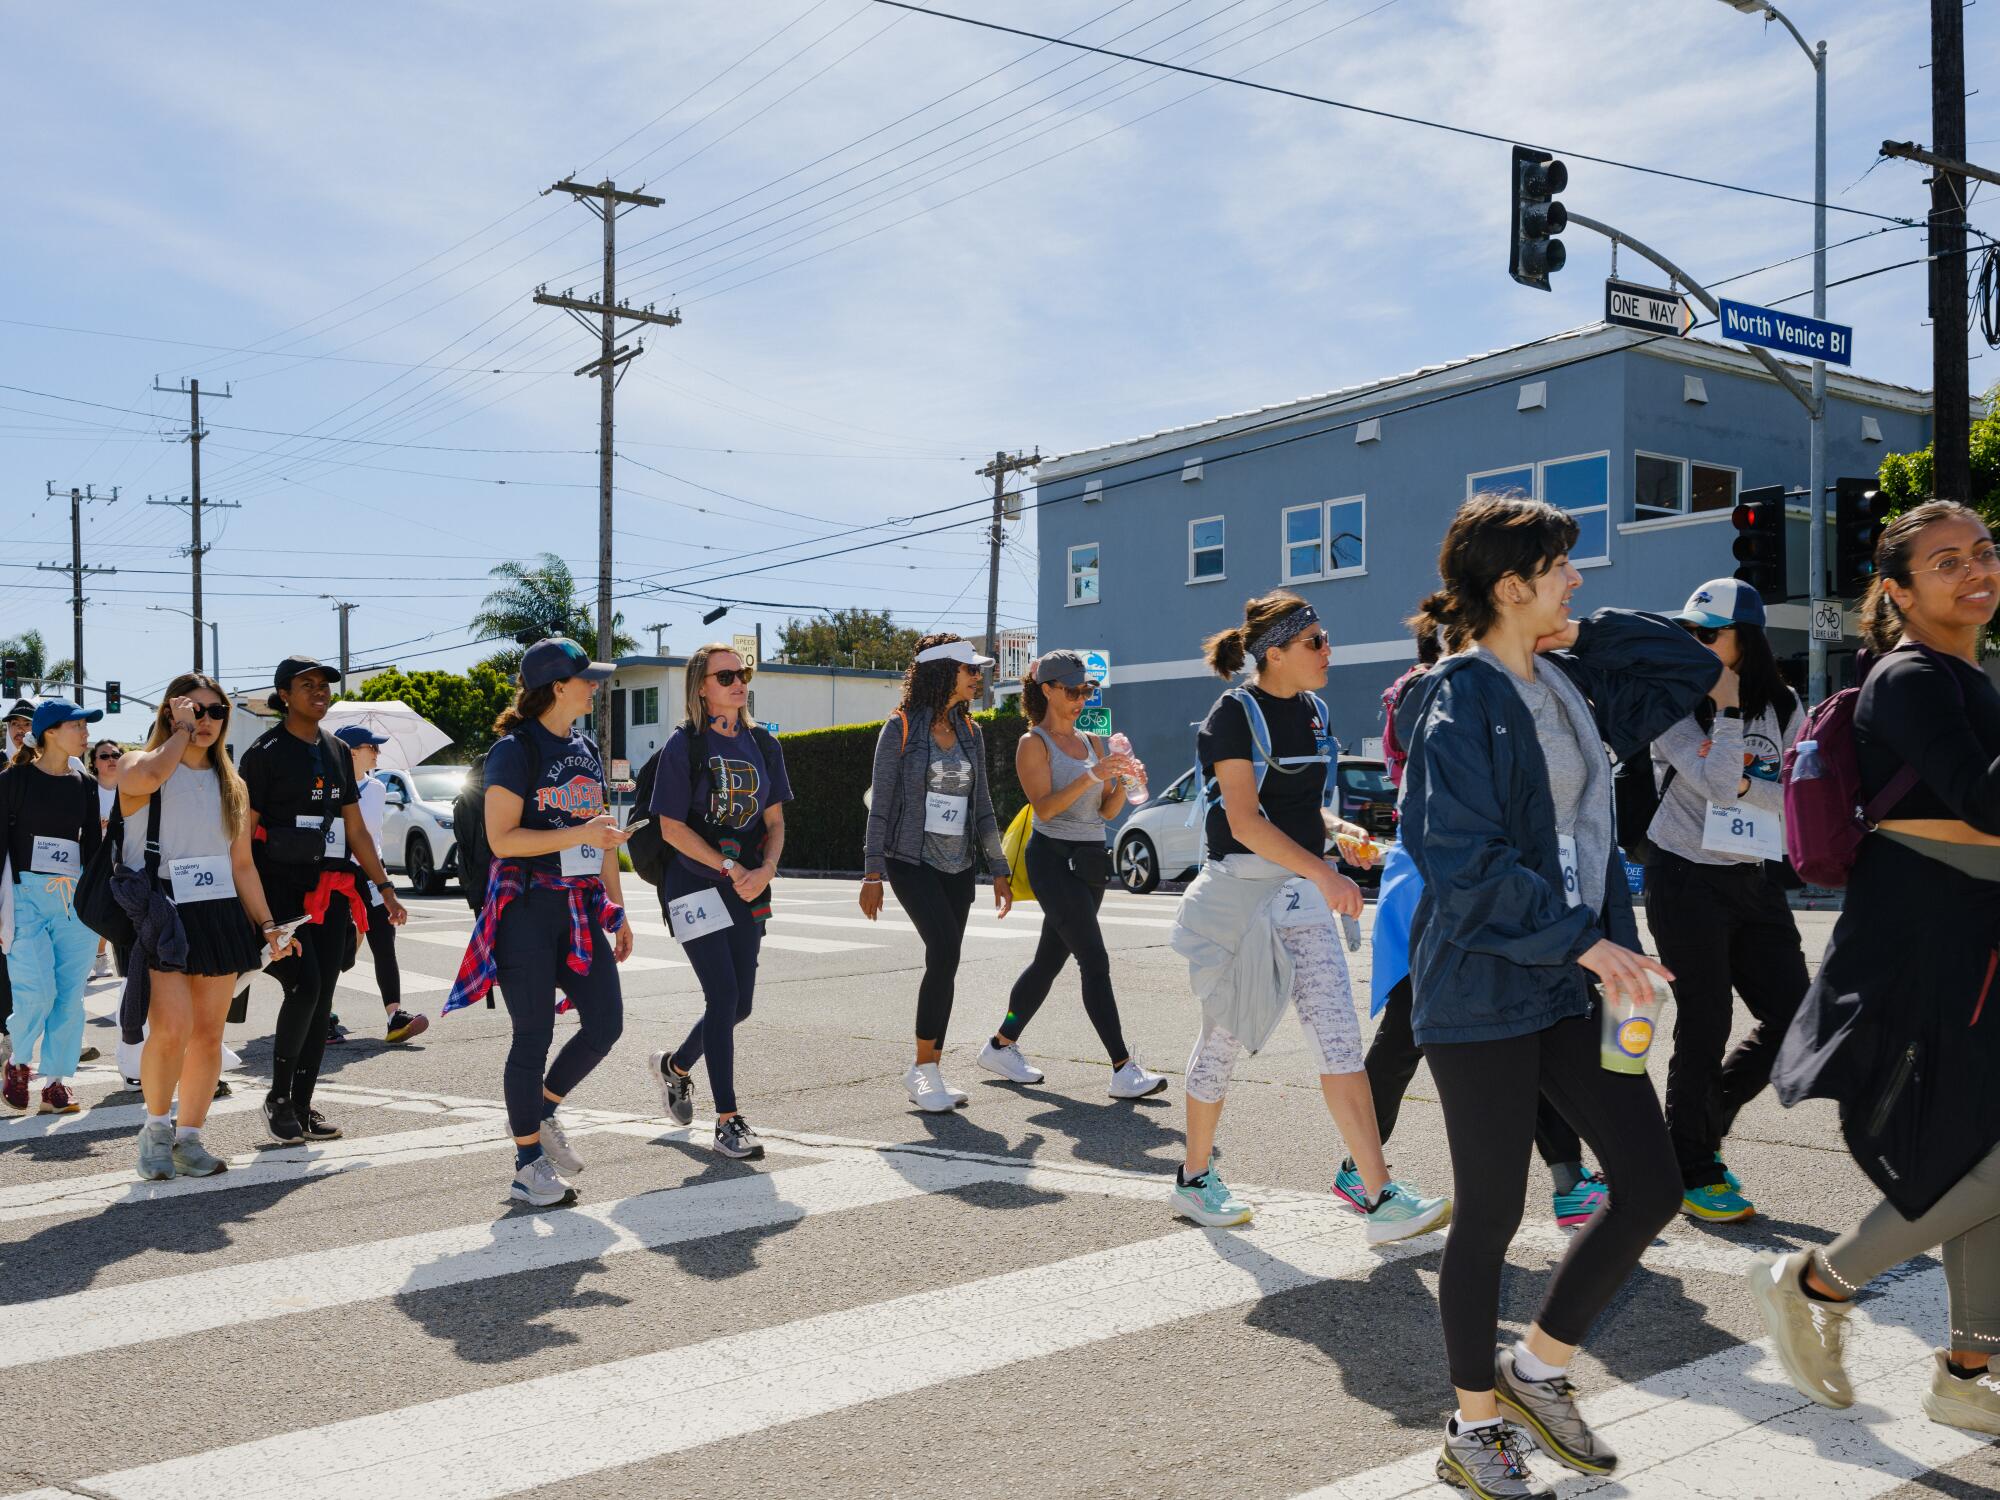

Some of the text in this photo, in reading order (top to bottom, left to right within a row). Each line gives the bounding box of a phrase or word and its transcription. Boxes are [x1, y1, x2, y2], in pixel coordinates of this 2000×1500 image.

[1612, 293, 1677, 324] ONE WAY
[1727, 308, 1846, 354] North Venice Bl
[1815, 629, 1839, 640] BIKE LANE
[735, 638, 756, 646] SPEED
[737, 645, 753, 653] LIMIT
[743, 654, 755, 667] 0
[546, 760, 566, 782] KIA
[311, 788, 340, 796] TOH
[536, 782, 603, 812] FOO FIGHT
[941, 809, 959, 822] 47
[1711, 809, 1729, 817] walk
[1730, 818, 1754, 838] 81
[325, 831, 336, 844] 8
[50, 850, 69, 863] 42
[580, 843, 596, 859] 65
[193, 871, 214, 887] 29
[1564, 865, 1578, 893] 6
[684, 906, 707, 925] 64
